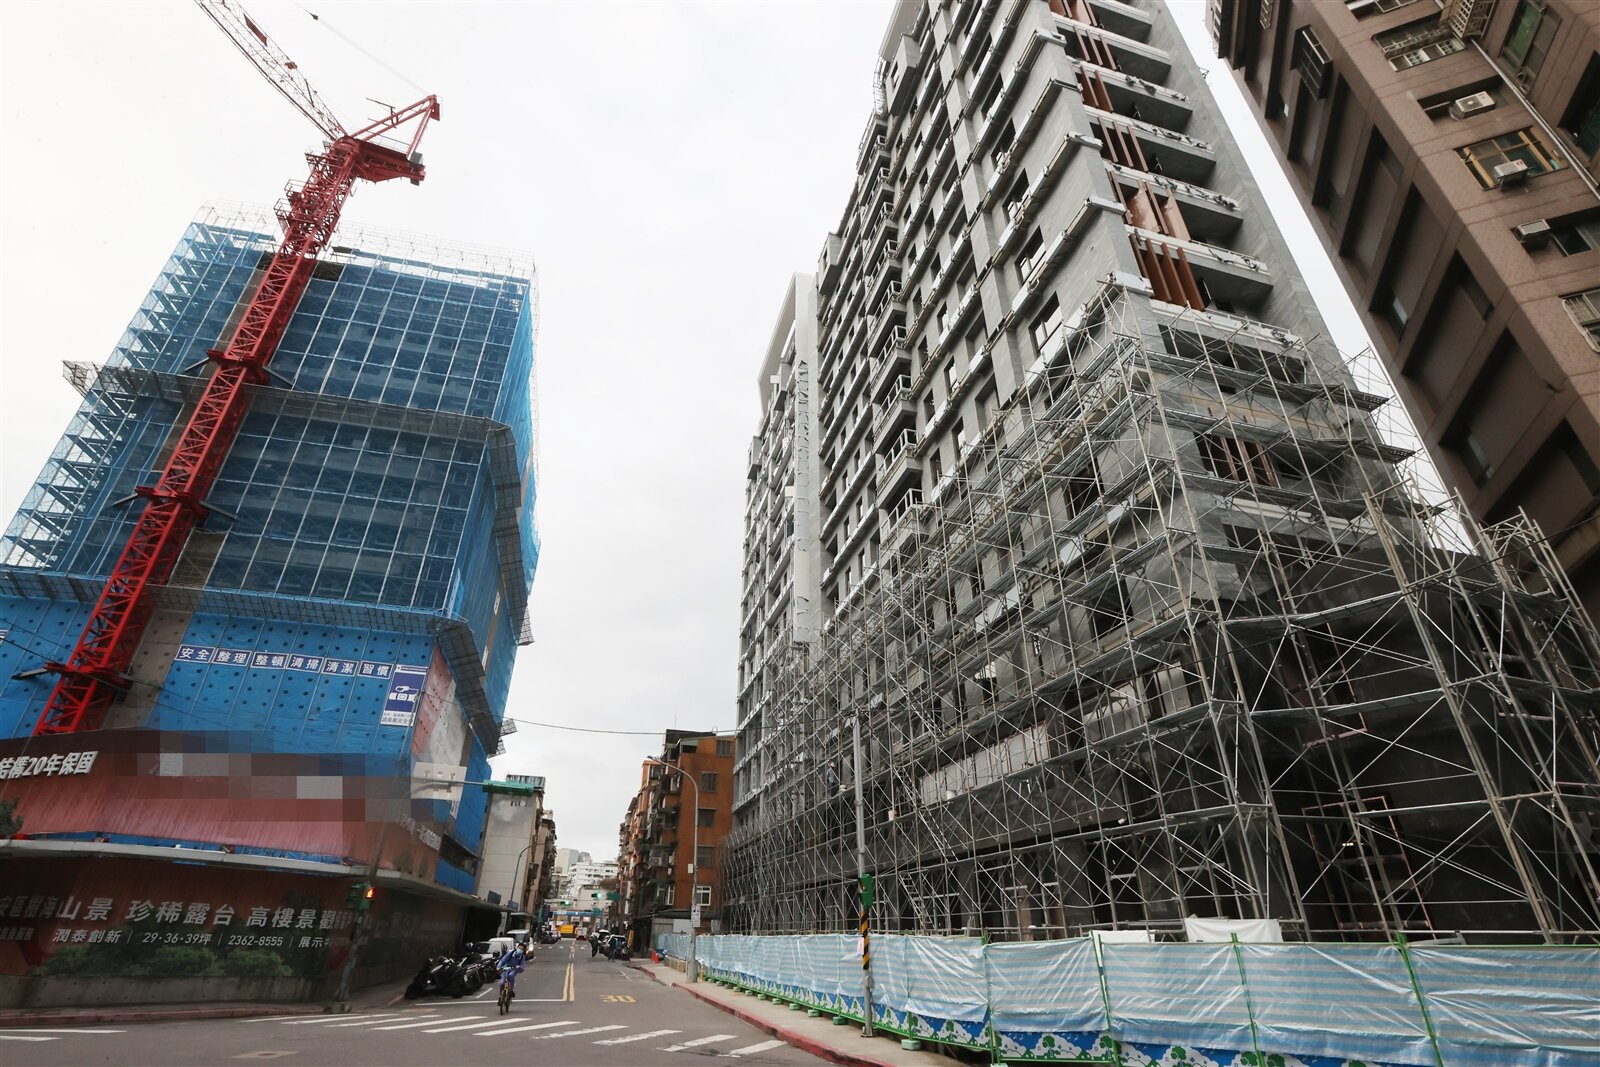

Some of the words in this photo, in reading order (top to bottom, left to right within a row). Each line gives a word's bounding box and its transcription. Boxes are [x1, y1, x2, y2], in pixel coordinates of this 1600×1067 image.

[179, 647, 211, 662] 安全
[212, 650, 247, 666] 整理
[253, 654, 286, 668] 整頓
[289, 656, 320, 672] 清掃
[325, 660, 355, 675] 清潔
[362, 663, 390, 677] 習慣
[125, 898, 236, 928] 珍稀露台
[52, 928, 122, 944] 潤泰創新
[227, 934, 284, 948] 2362-8555
[599, 993, 637, 1003] 30
